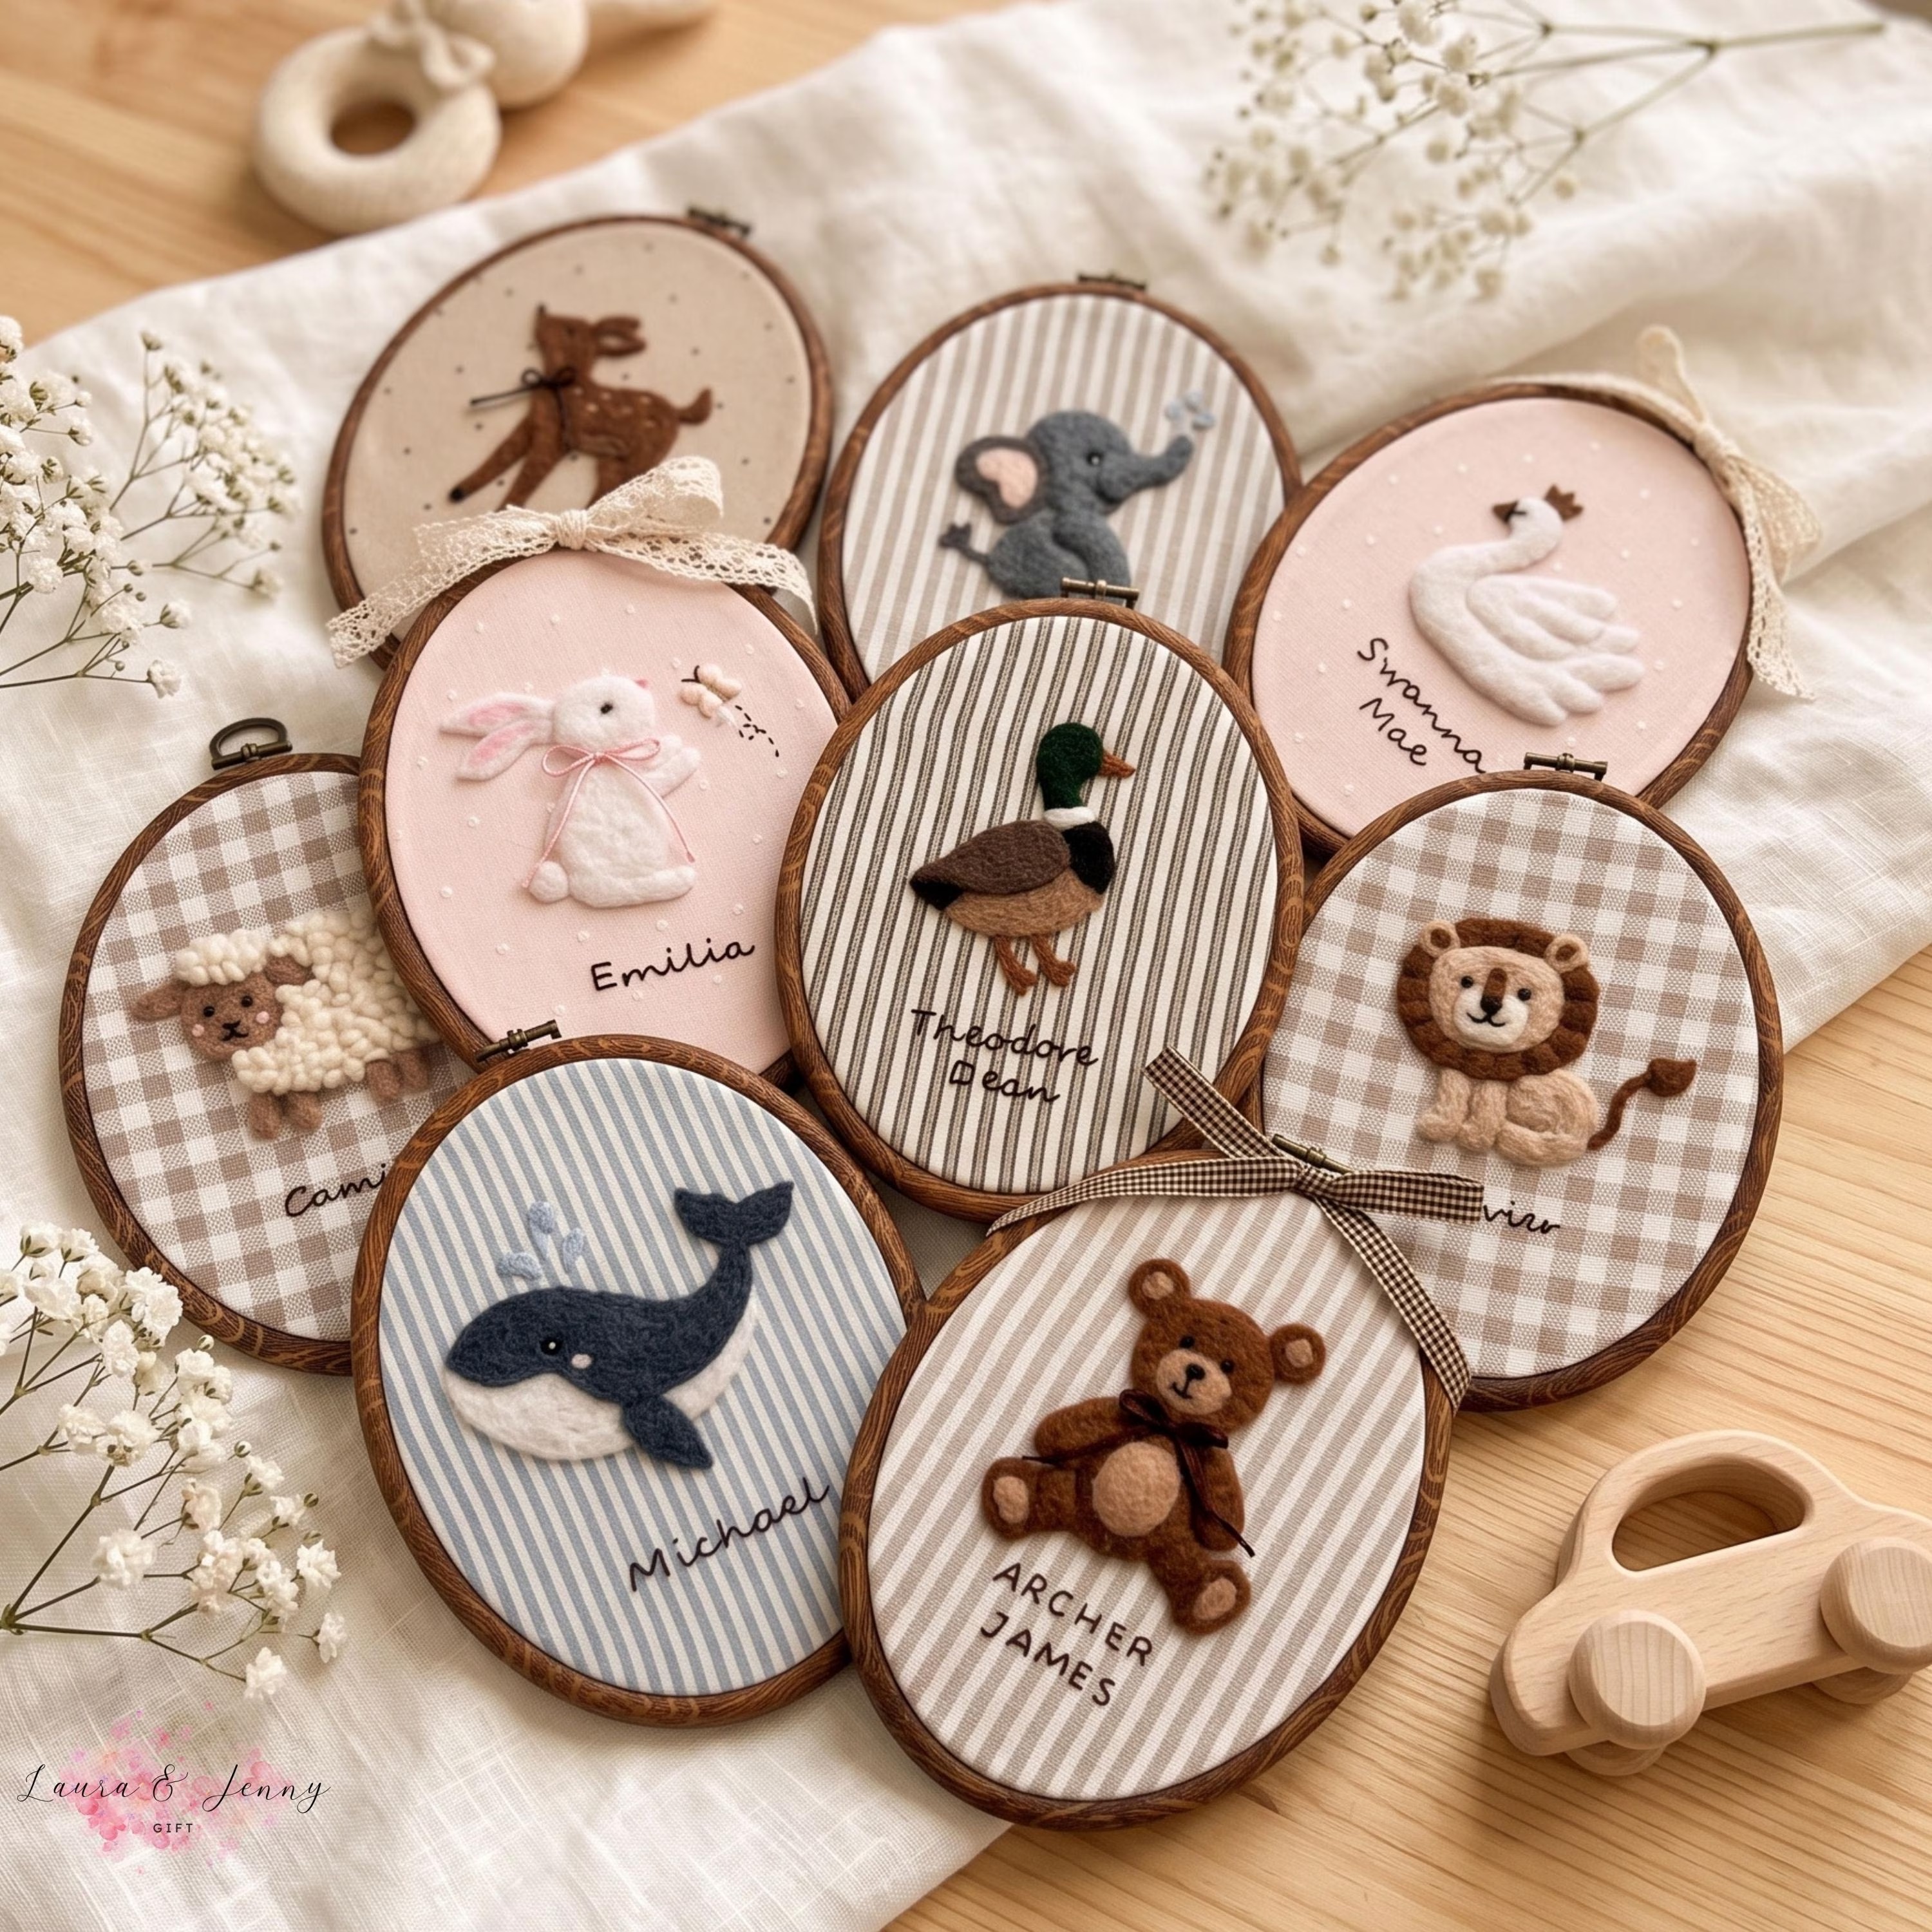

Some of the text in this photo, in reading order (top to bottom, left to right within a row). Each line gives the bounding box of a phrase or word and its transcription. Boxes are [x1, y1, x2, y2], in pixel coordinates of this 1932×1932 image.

[1357, 638, 1486, 773] Swanna
[1359, 697, 1427, 766] Mae
[591, 938, 755, 991] Emilia
[911, 1009, 1099, 1066] Theodore
[949, 1059, 1060, 1102] Dean
[629, 1477, 830, 1592] Michael
[992, 1562, 1153, 1667] ARCHER
[980, 1611, 1115, 1707] JAMES
